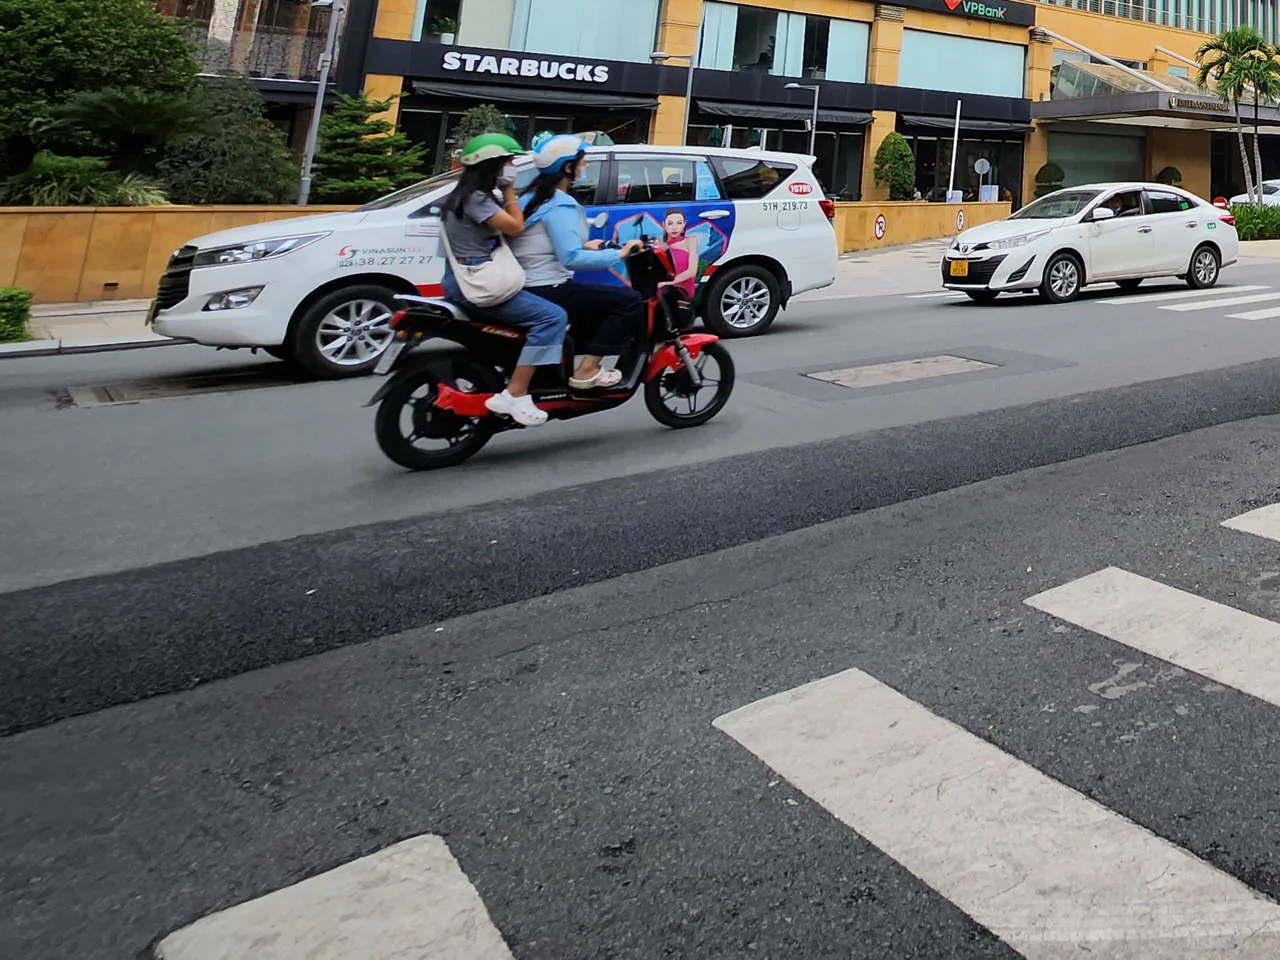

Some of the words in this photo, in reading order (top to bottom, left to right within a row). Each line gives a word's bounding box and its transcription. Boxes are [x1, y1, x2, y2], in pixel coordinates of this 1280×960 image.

[962, 0, 1005, 19] VPBank
[442, 51, 609, 83] STARBUCKS
[763, 202, 778, 211] 51H
[782, 201, 808, 211] 219.73
[361, 247, 406, 255] VINASUN
